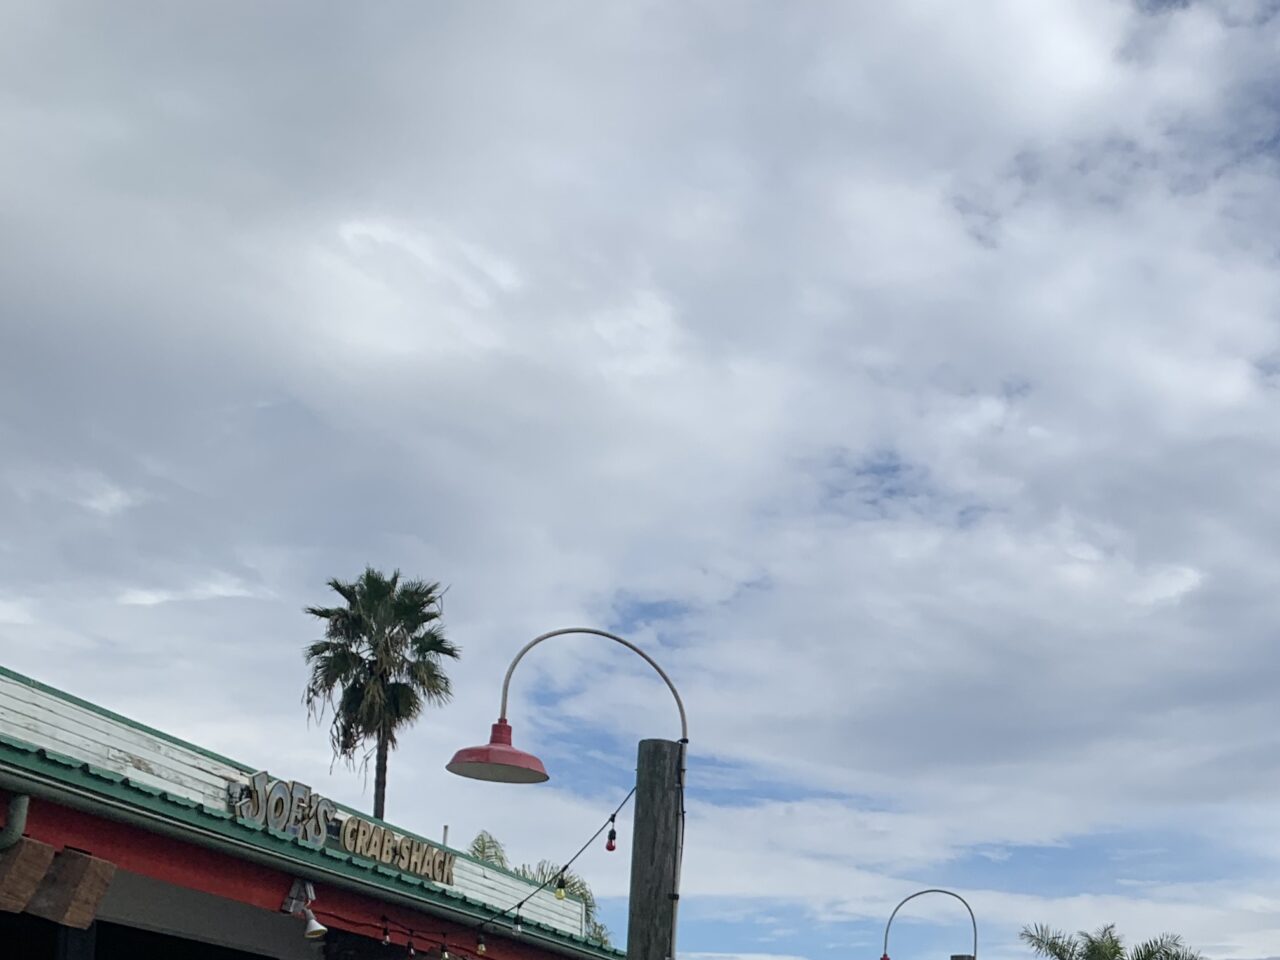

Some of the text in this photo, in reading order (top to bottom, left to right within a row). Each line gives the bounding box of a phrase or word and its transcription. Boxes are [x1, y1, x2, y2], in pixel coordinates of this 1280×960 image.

[235, 770, 337, 848] JOE'S
[341, 816, 457, 886] CRAB SHACK
